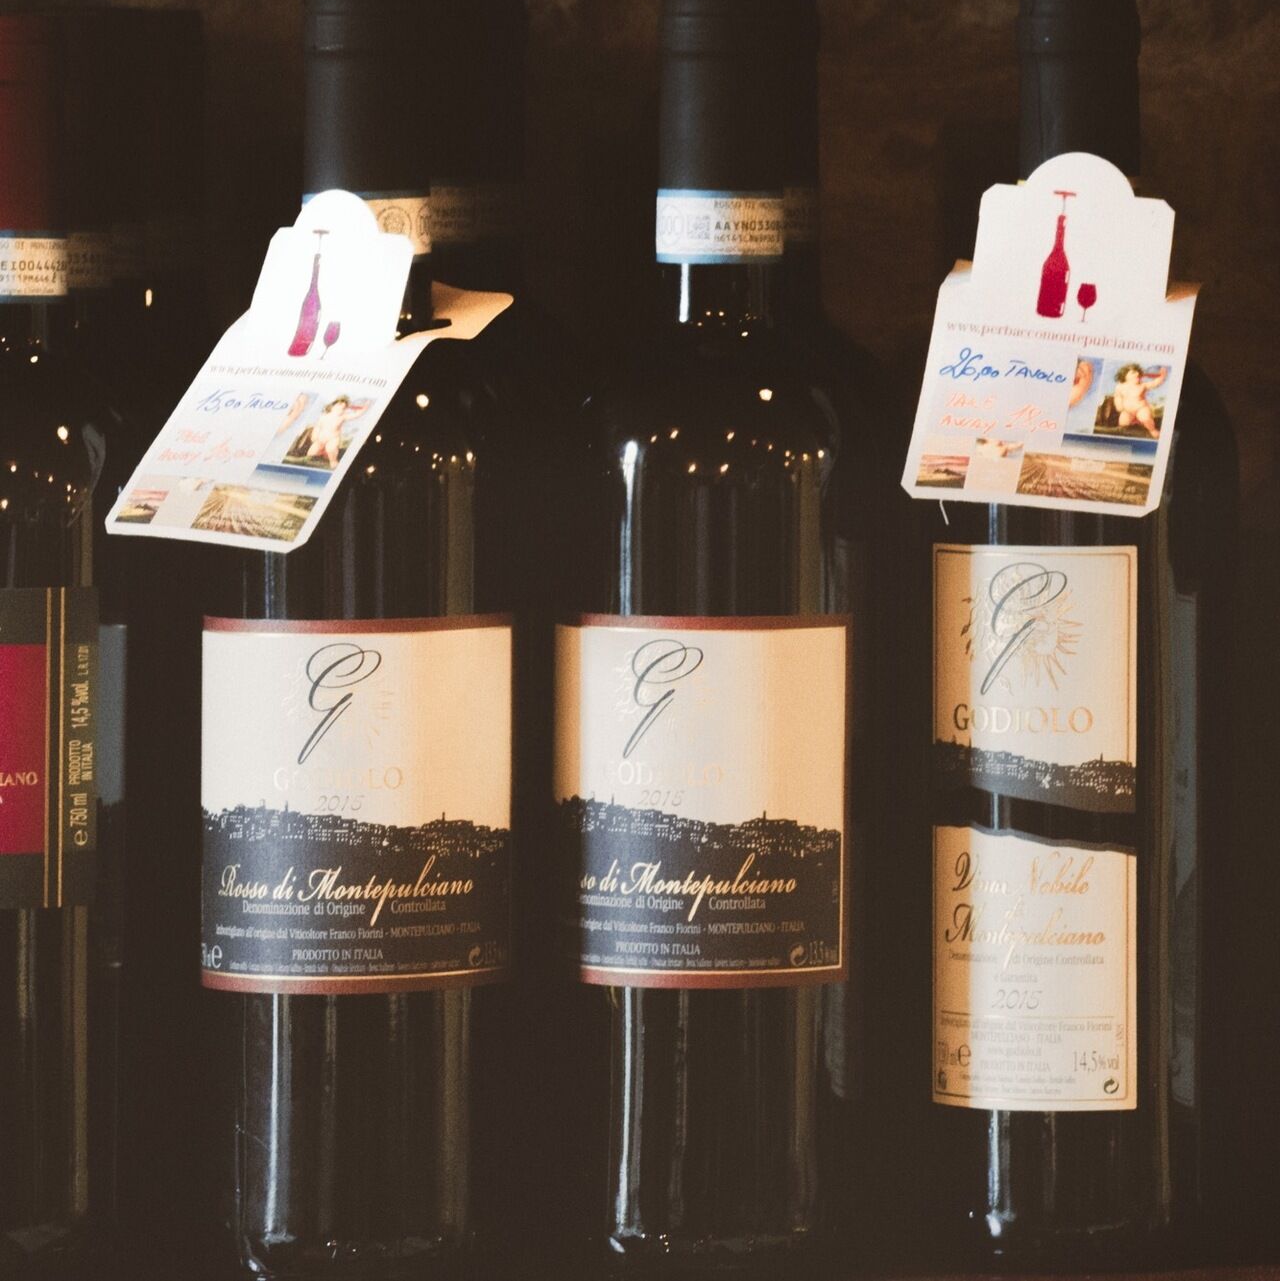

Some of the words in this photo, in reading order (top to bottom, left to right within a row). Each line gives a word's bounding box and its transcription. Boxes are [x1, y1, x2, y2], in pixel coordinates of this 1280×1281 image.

[218, 863, 268, 899] Rosso
[272, 865, 295, 901] di
[297, 855, 475, 927] Montepulciano
[242, 900, 311, 915] Denominazione
[326, 901, 367, 917] Origine
[390, 898, 447, 913] Controllata
[620, 853, 798, 922] Montepulciano
[708, 895, 766, 910] Controllata
